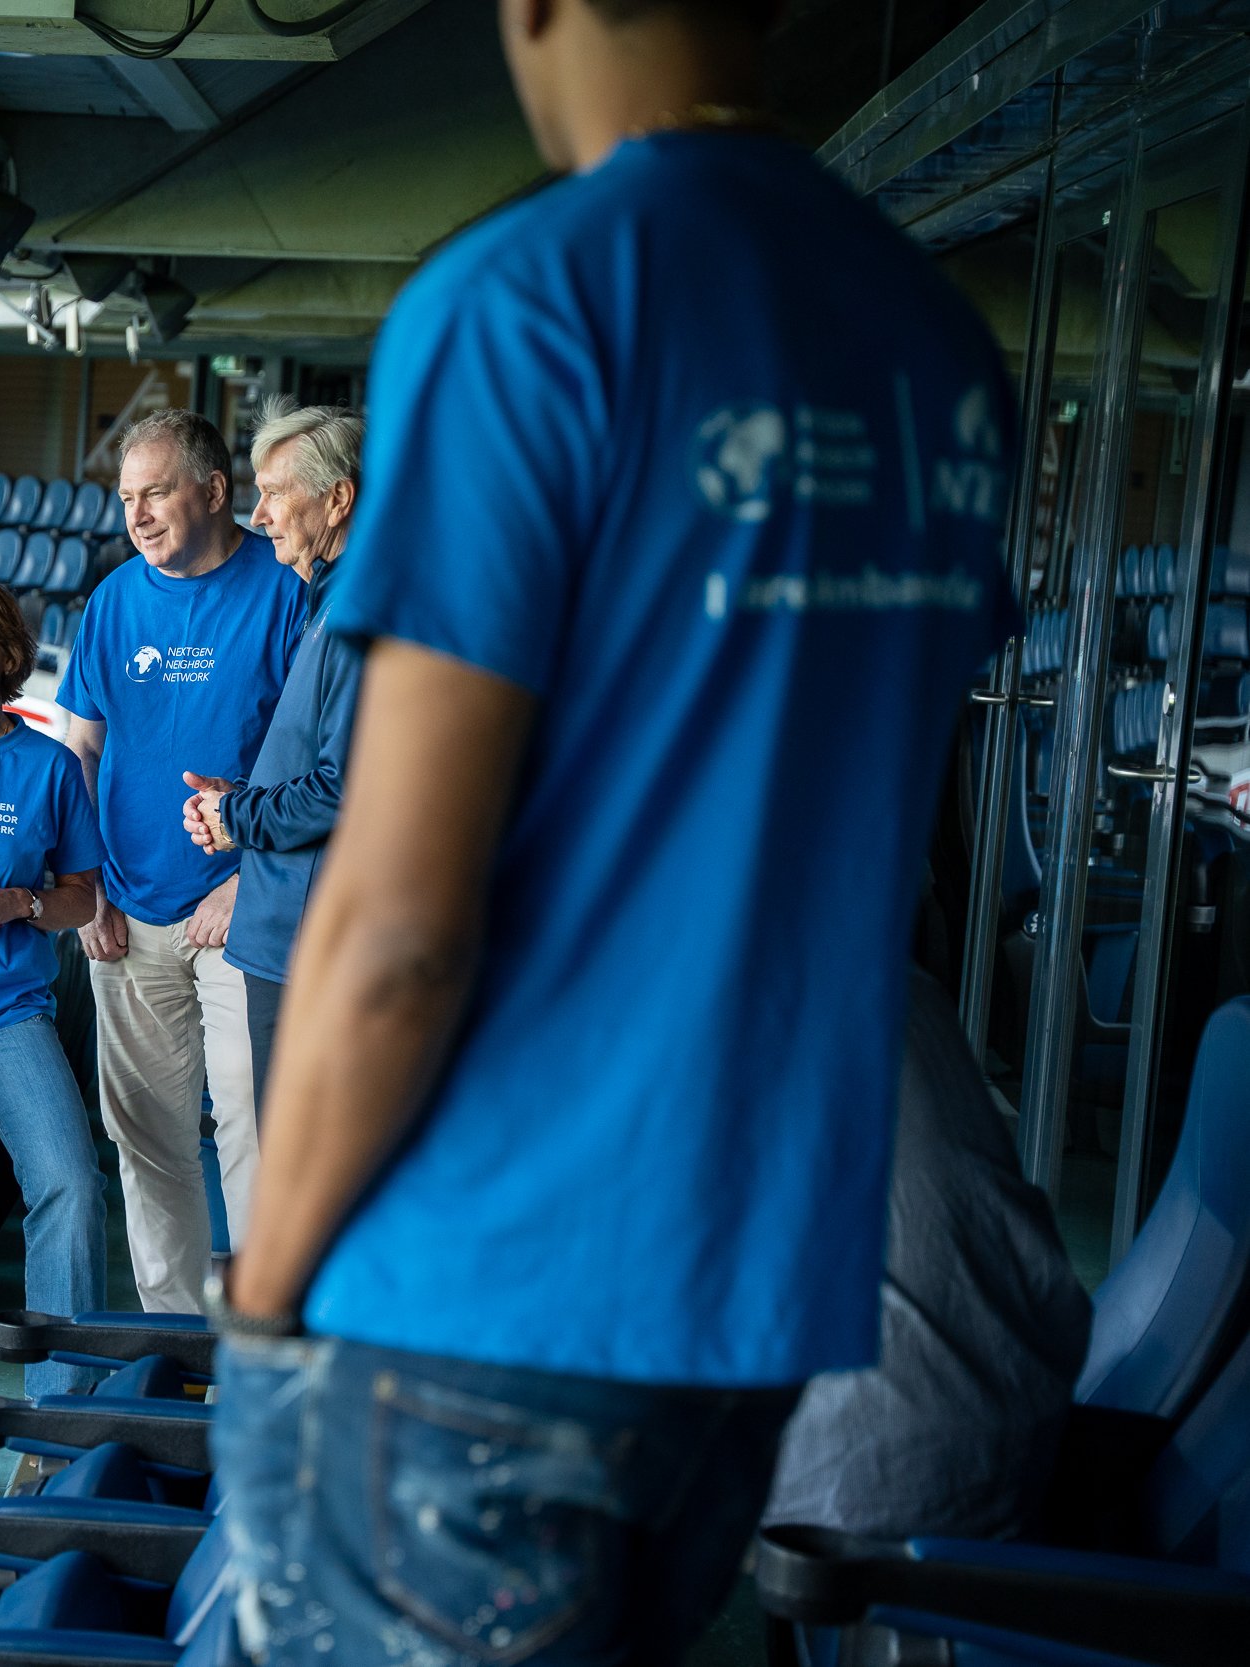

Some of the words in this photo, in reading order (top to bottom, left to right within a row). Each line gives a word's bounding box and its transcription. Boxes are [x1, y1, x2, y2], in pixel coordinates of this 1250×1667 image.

[167, 646, 214, 657] NEXTGEN
[165, 660, 215, 669] NEIGHBOR
[162, 672, 210, 682] NETWORK
